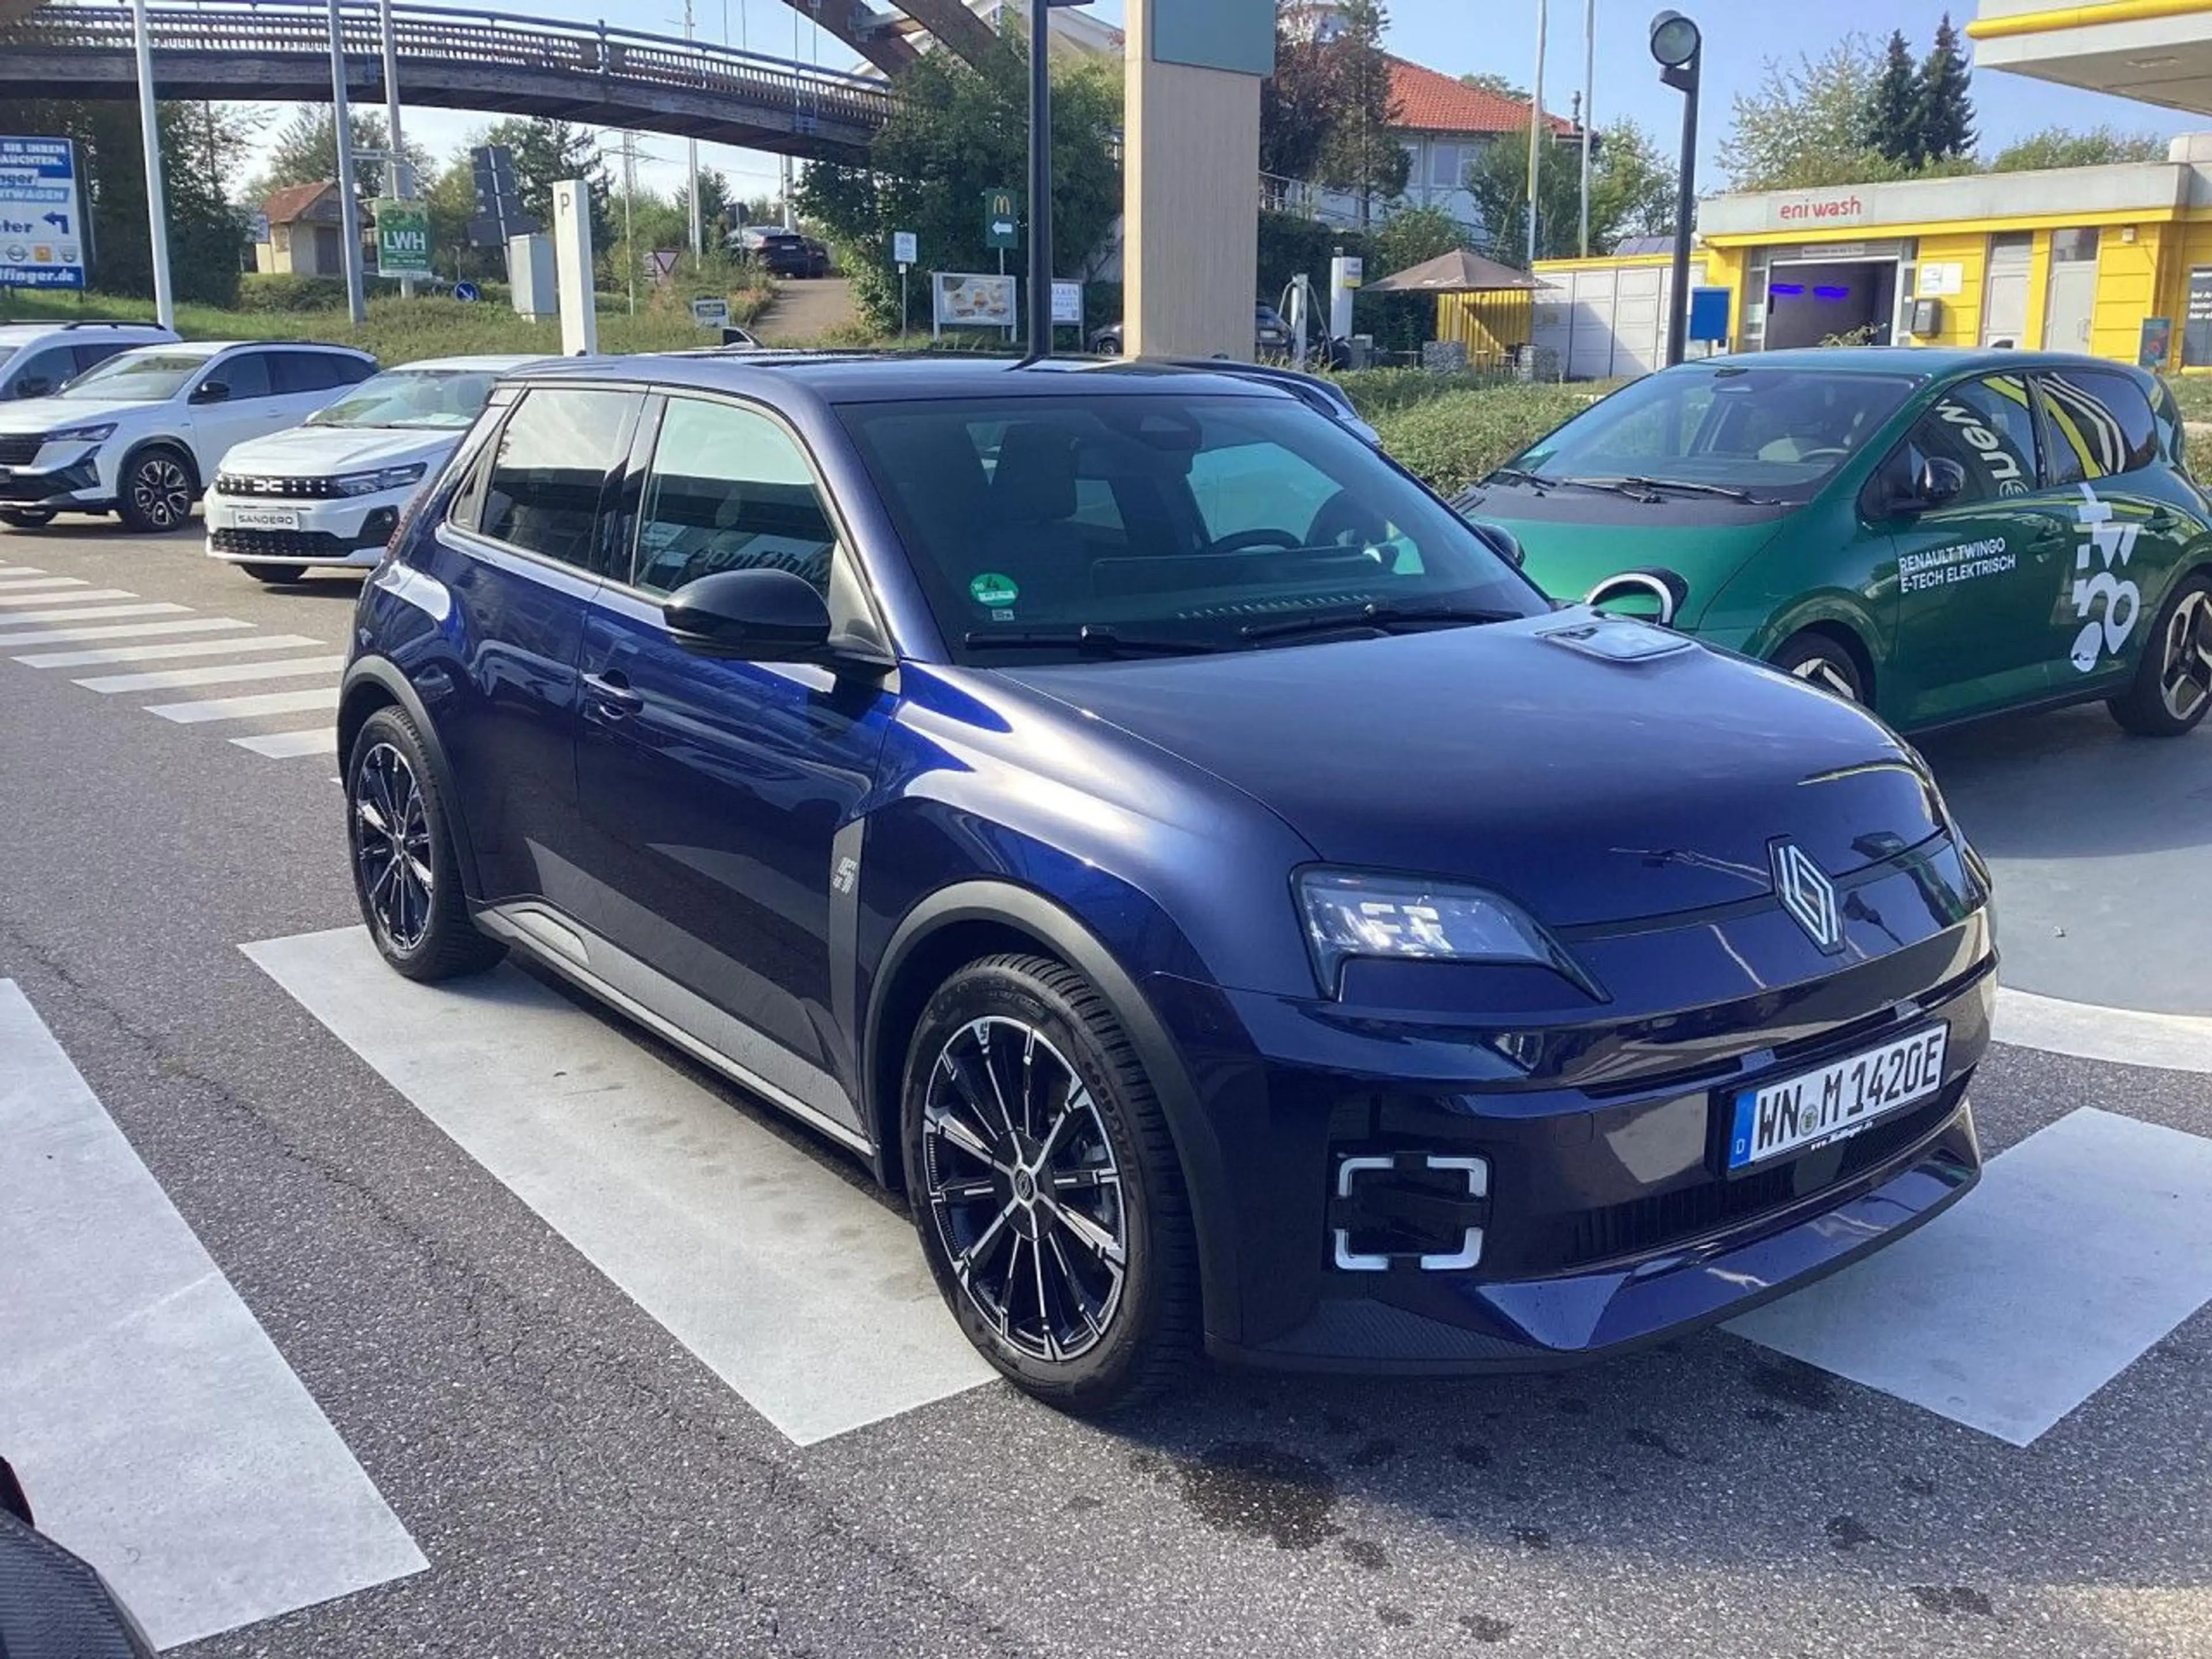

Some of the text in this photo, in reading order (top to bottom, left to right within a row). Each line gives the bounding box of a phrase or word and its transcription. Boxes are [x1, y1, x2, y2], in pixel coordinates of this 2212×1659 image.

[1780, 195, 1861, 219] eni wash
[384, 230, 426, 250] LWH
[237, 514, 293, 525] SANDERO
[1899, 536, 2006, 574] RENAULT TWINGO
[1901, 554, 2016, 593] E-TECH ELEKTRISCH
[1758, 1084, 1802, 1150] WN
[1820, 1069, 1843, 1128] M
[1847, 1033, 1942, 1116] 1420E
[1736, 1138, 1744, 1154] D
